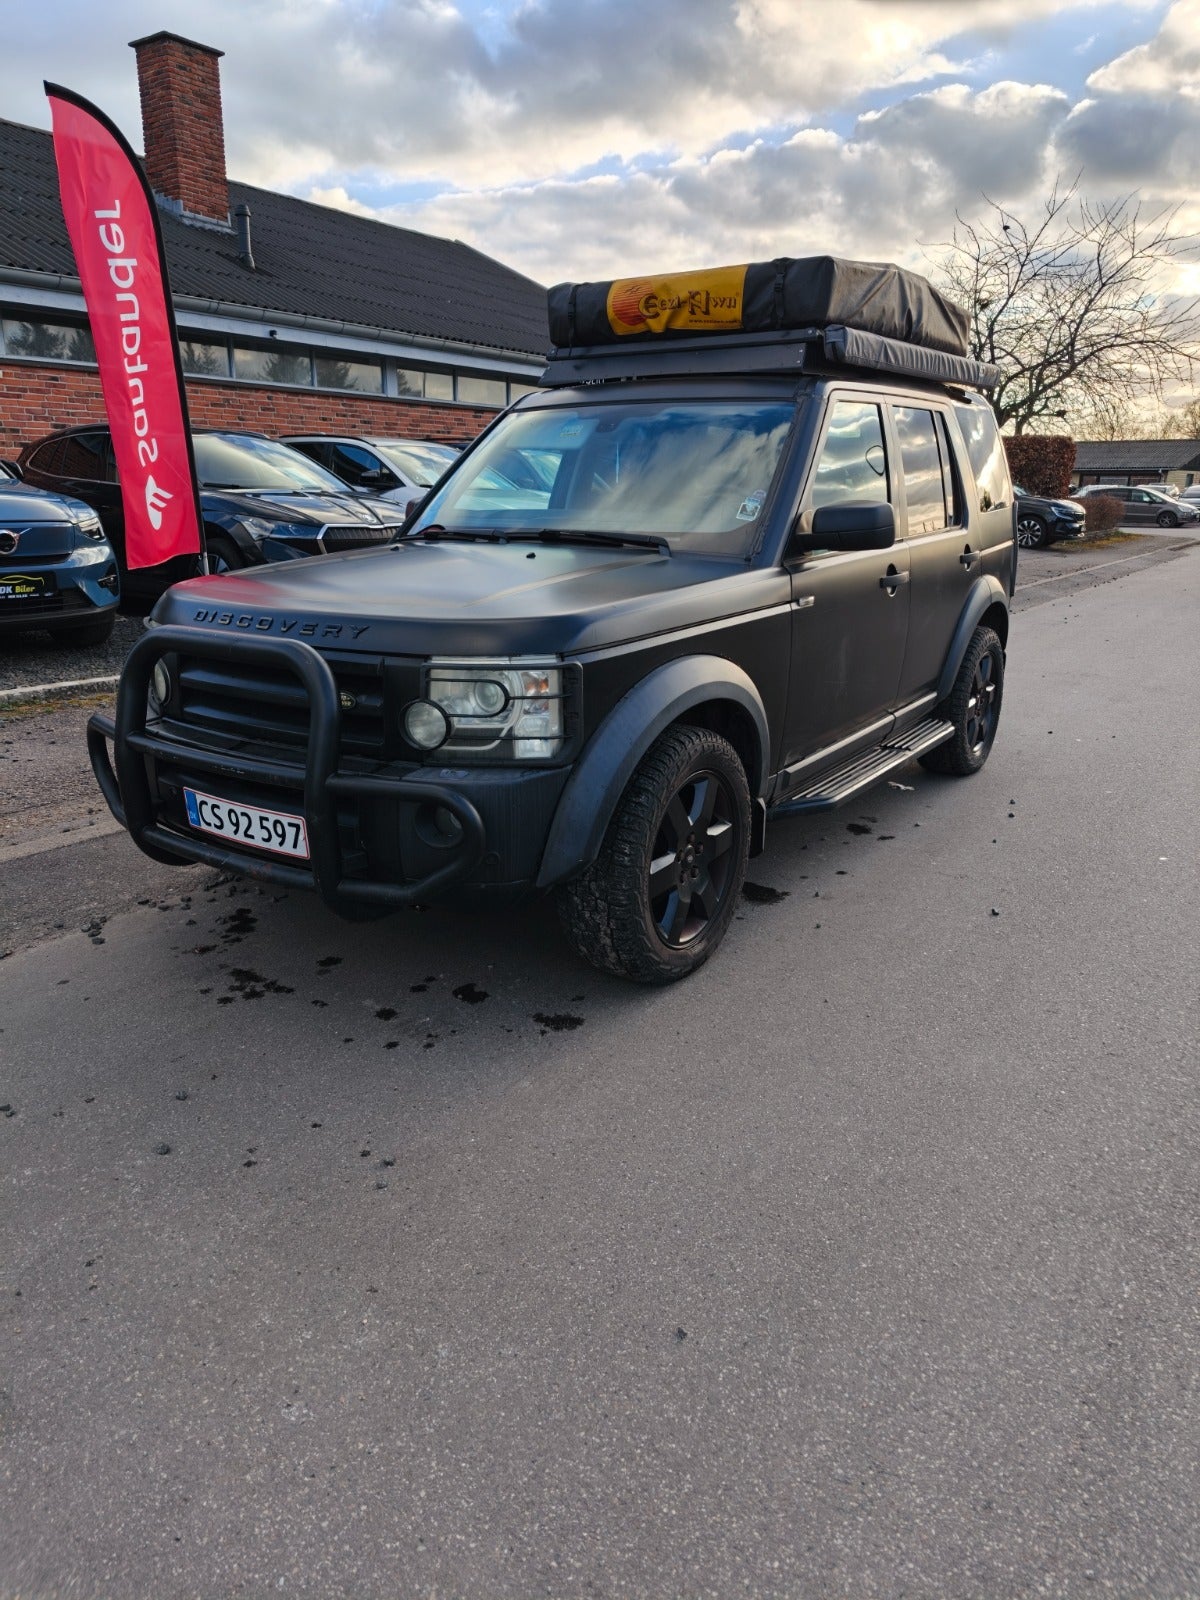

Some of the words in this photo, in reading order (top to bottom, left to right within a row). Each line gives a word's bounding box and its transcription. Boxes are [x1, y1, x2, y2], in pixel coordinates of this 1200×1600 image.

[15, 584, 35, 593] Biler
[192, 608, 371, 640] DISCOVERY
[198, 799, 225, 831] CS
[227, 808, 255, 840] 92
[258, 815, 301, 850] 597
